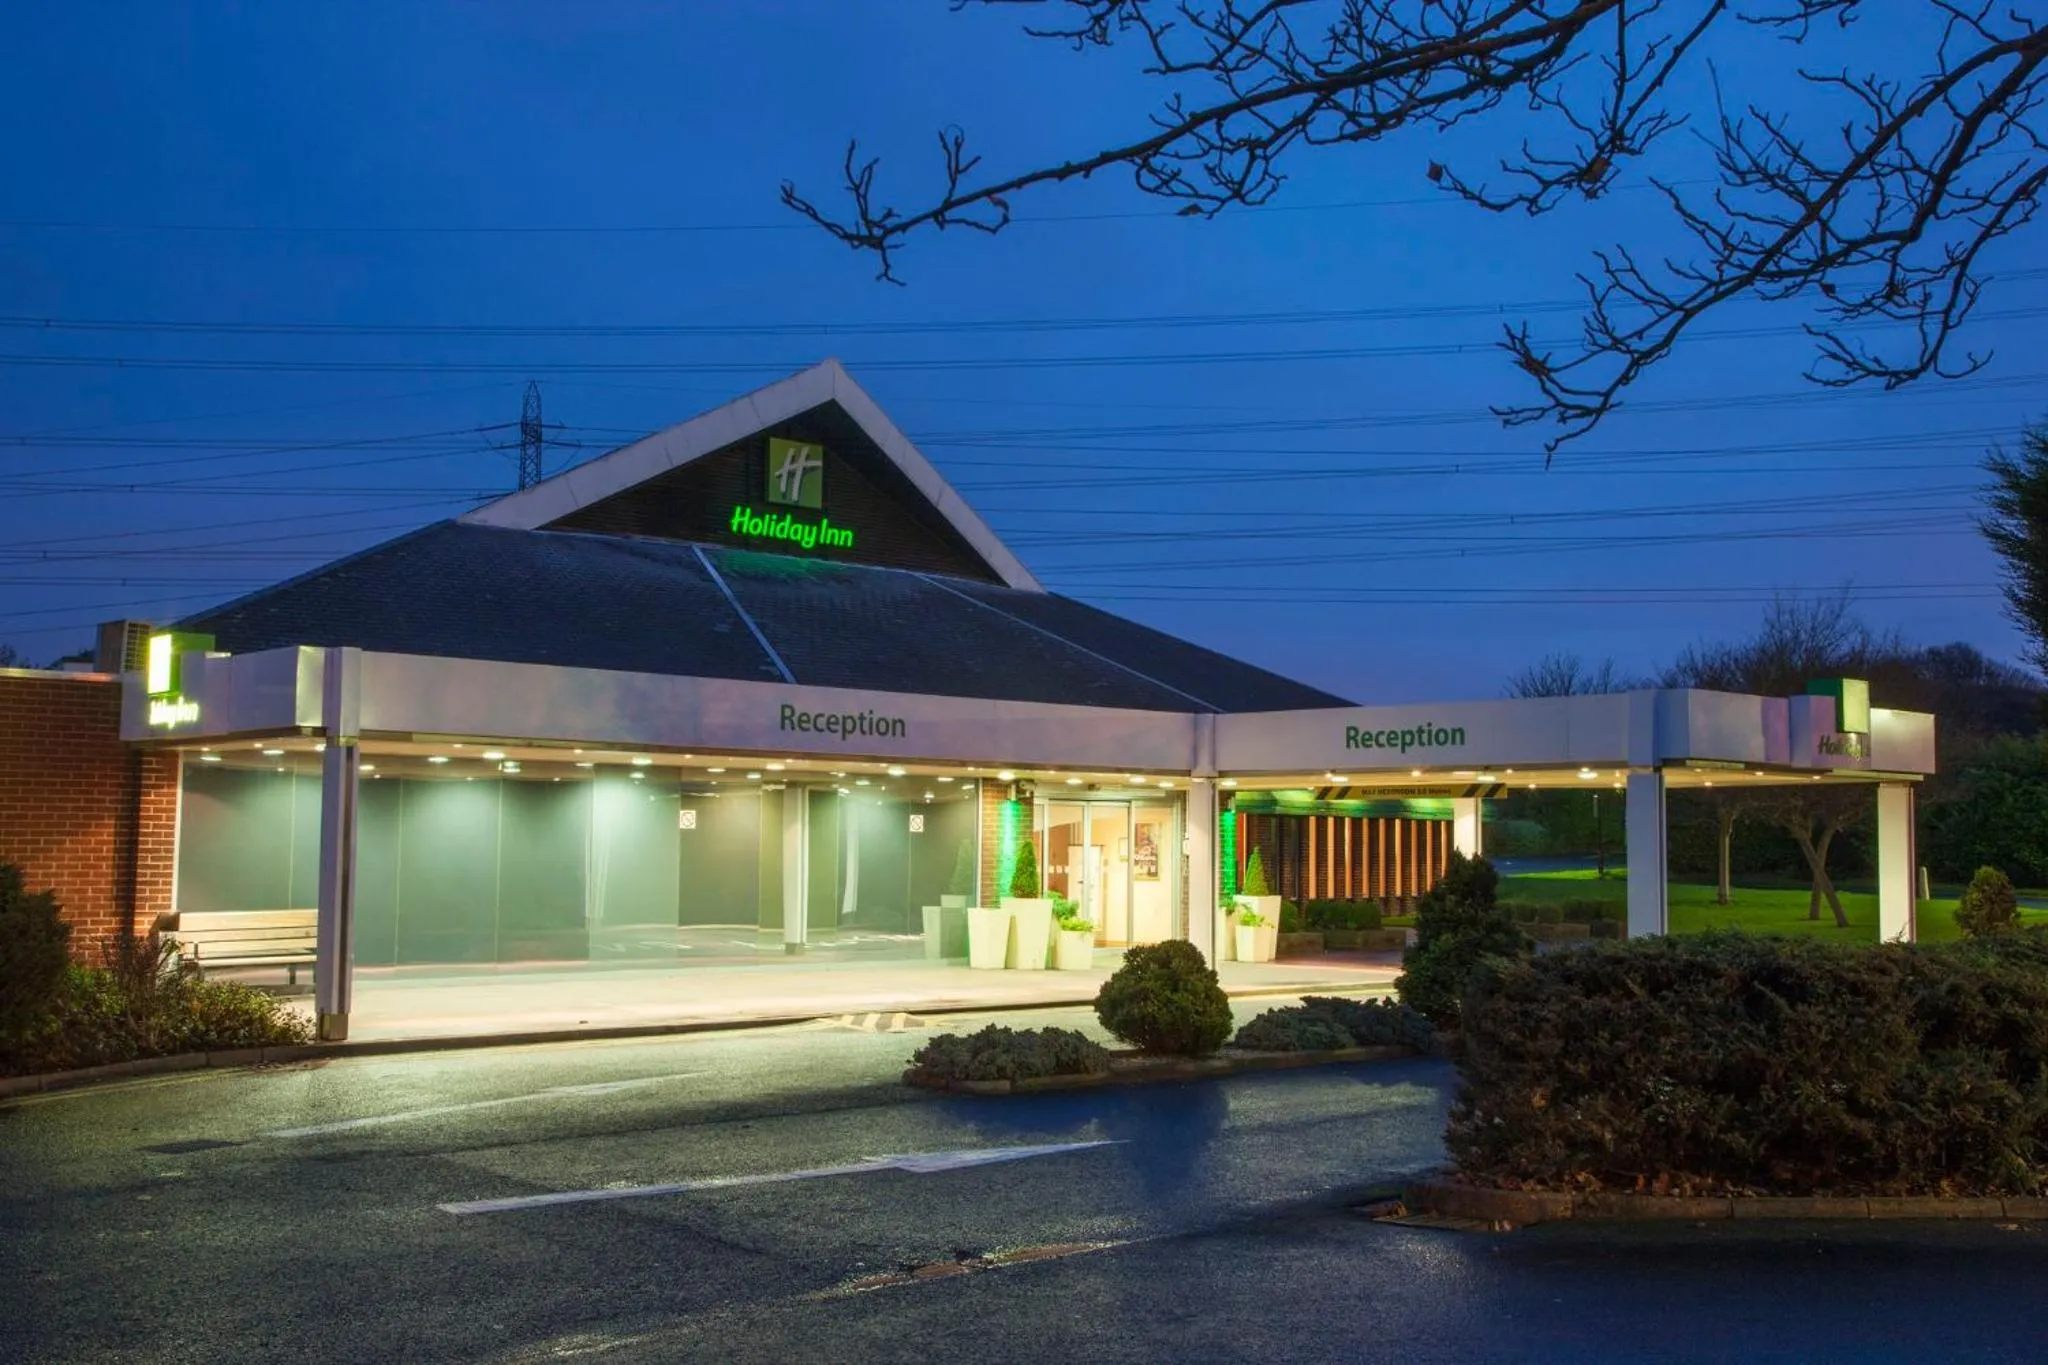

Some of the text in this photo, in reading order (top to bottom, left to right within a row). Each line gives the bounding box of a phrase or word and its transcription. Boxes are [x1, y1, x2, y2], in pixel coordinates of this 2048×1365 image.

[731, 505, 854, 549] Holiday Inn
[780, 703, 906, 741] Reception
[1345, 721, 1465, 754] Reception
